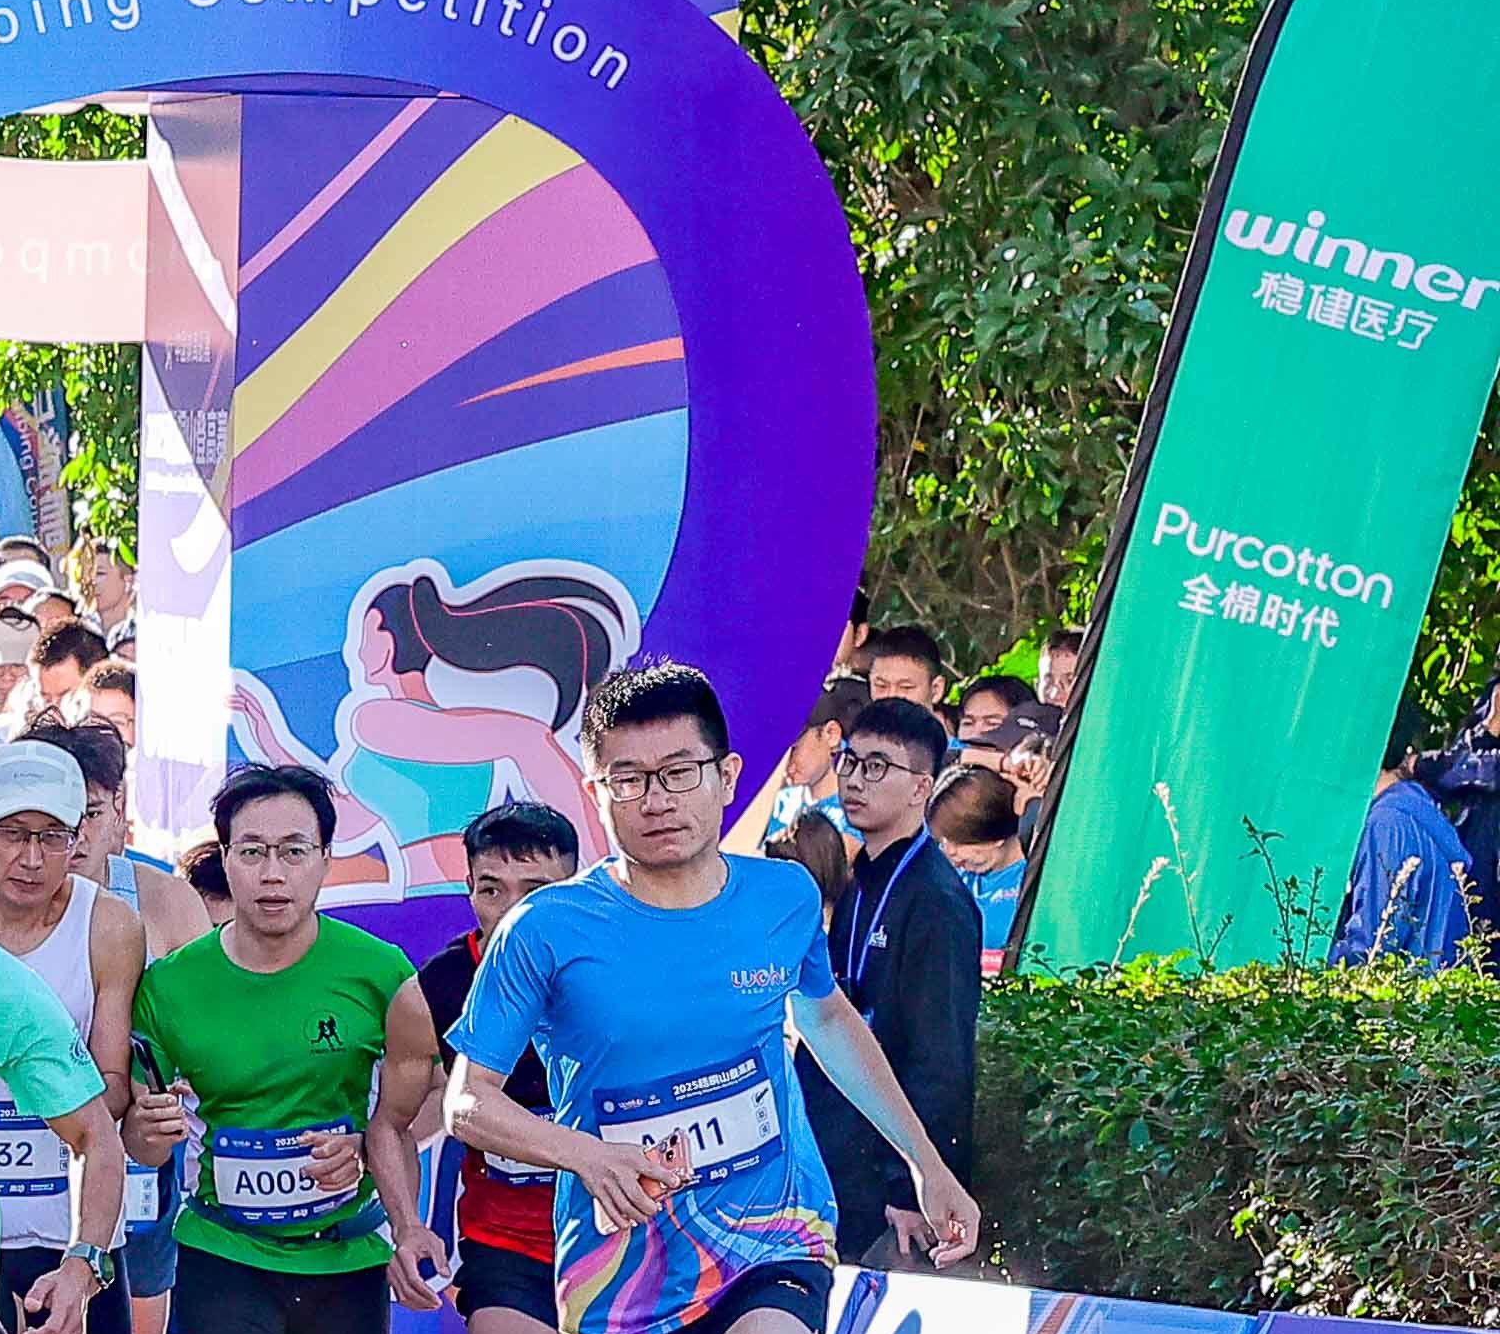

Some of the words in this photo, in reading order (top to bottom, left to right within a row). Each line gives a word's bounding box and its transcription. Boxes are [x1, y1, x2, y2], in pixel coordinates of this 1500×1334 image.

[1251, 271, 1440, 352] 稳健医疗
[1152, 502, 1393, 610] Purcotton
[1179, 572, 1340, 649] 全棉时代
